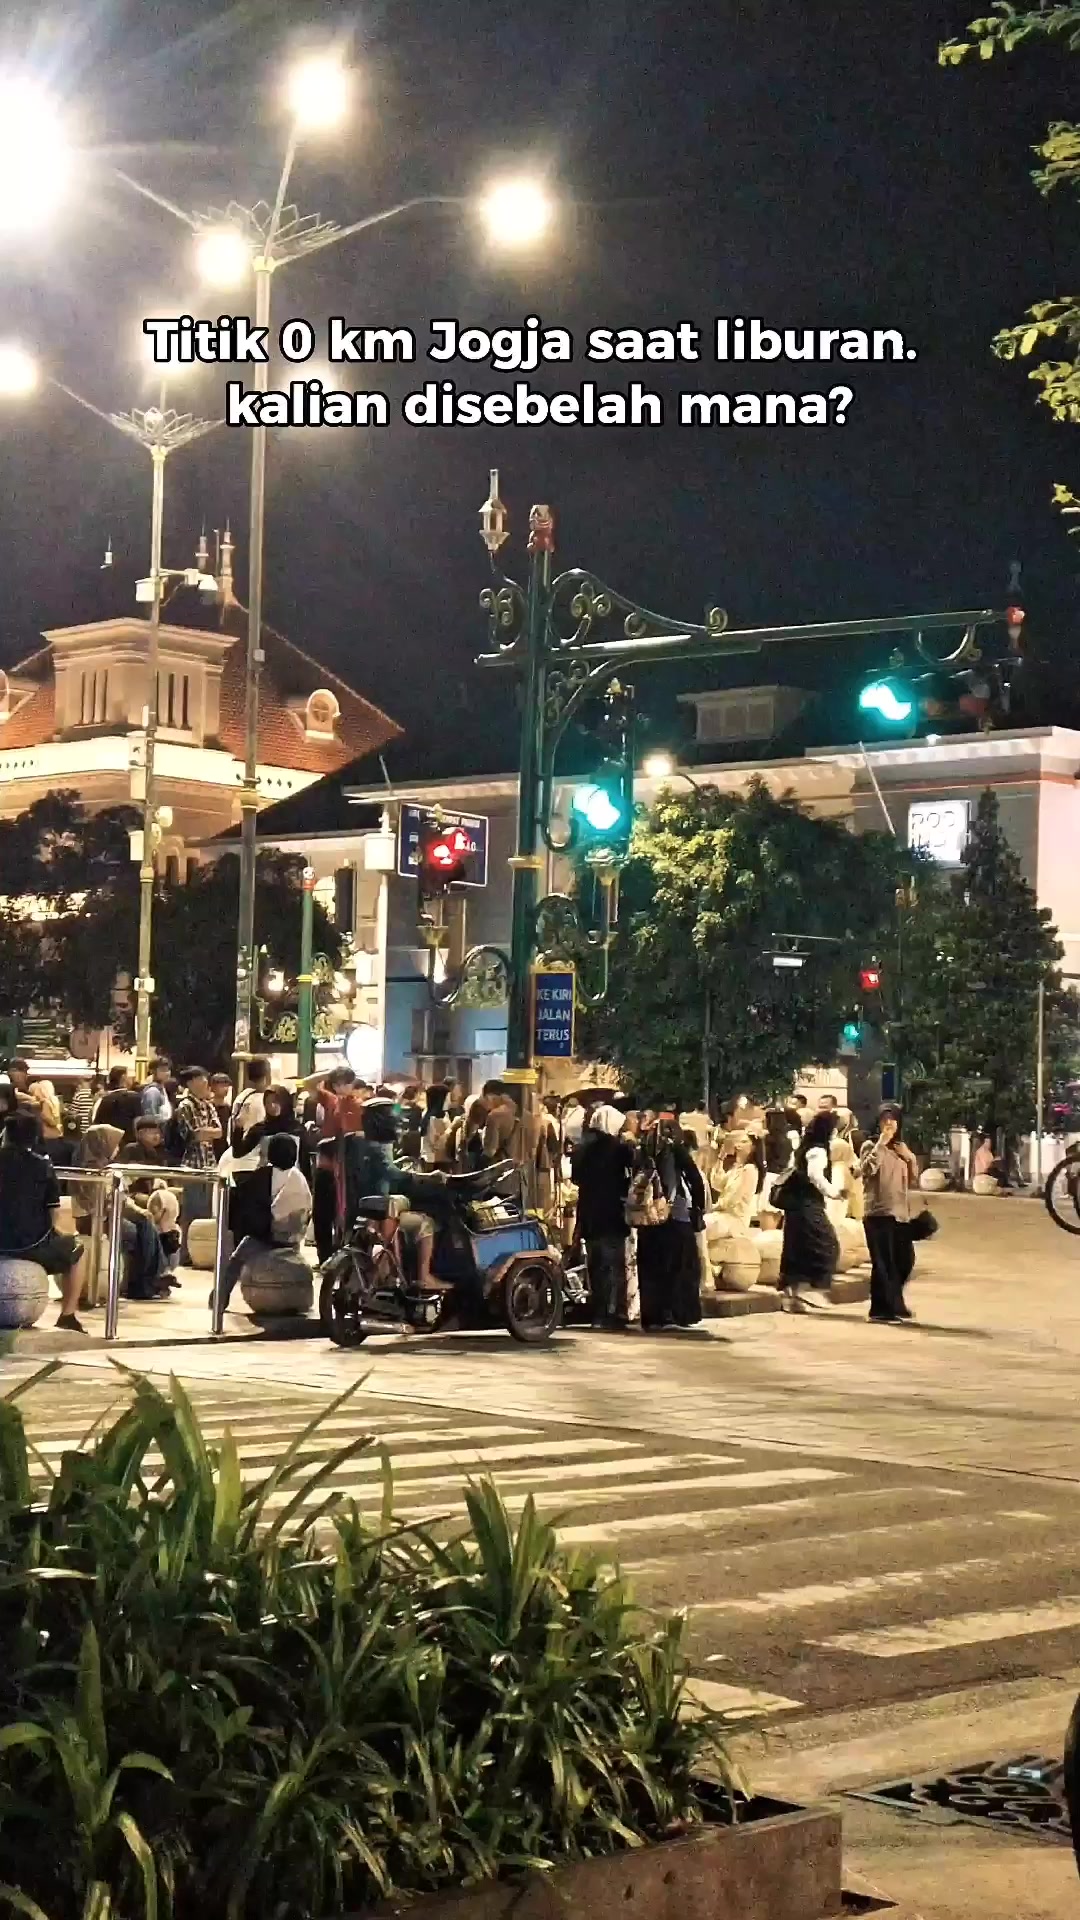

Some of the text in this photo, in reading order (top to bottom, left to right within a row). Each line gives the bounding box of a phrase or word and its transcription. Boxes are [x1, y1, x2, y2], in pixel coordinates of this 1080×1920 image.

[536, 988, 572, 1000] KE KIRI
[538, 1007, 571, 1021] JALAN
[536, 1028, 570, 1041] TERUS
